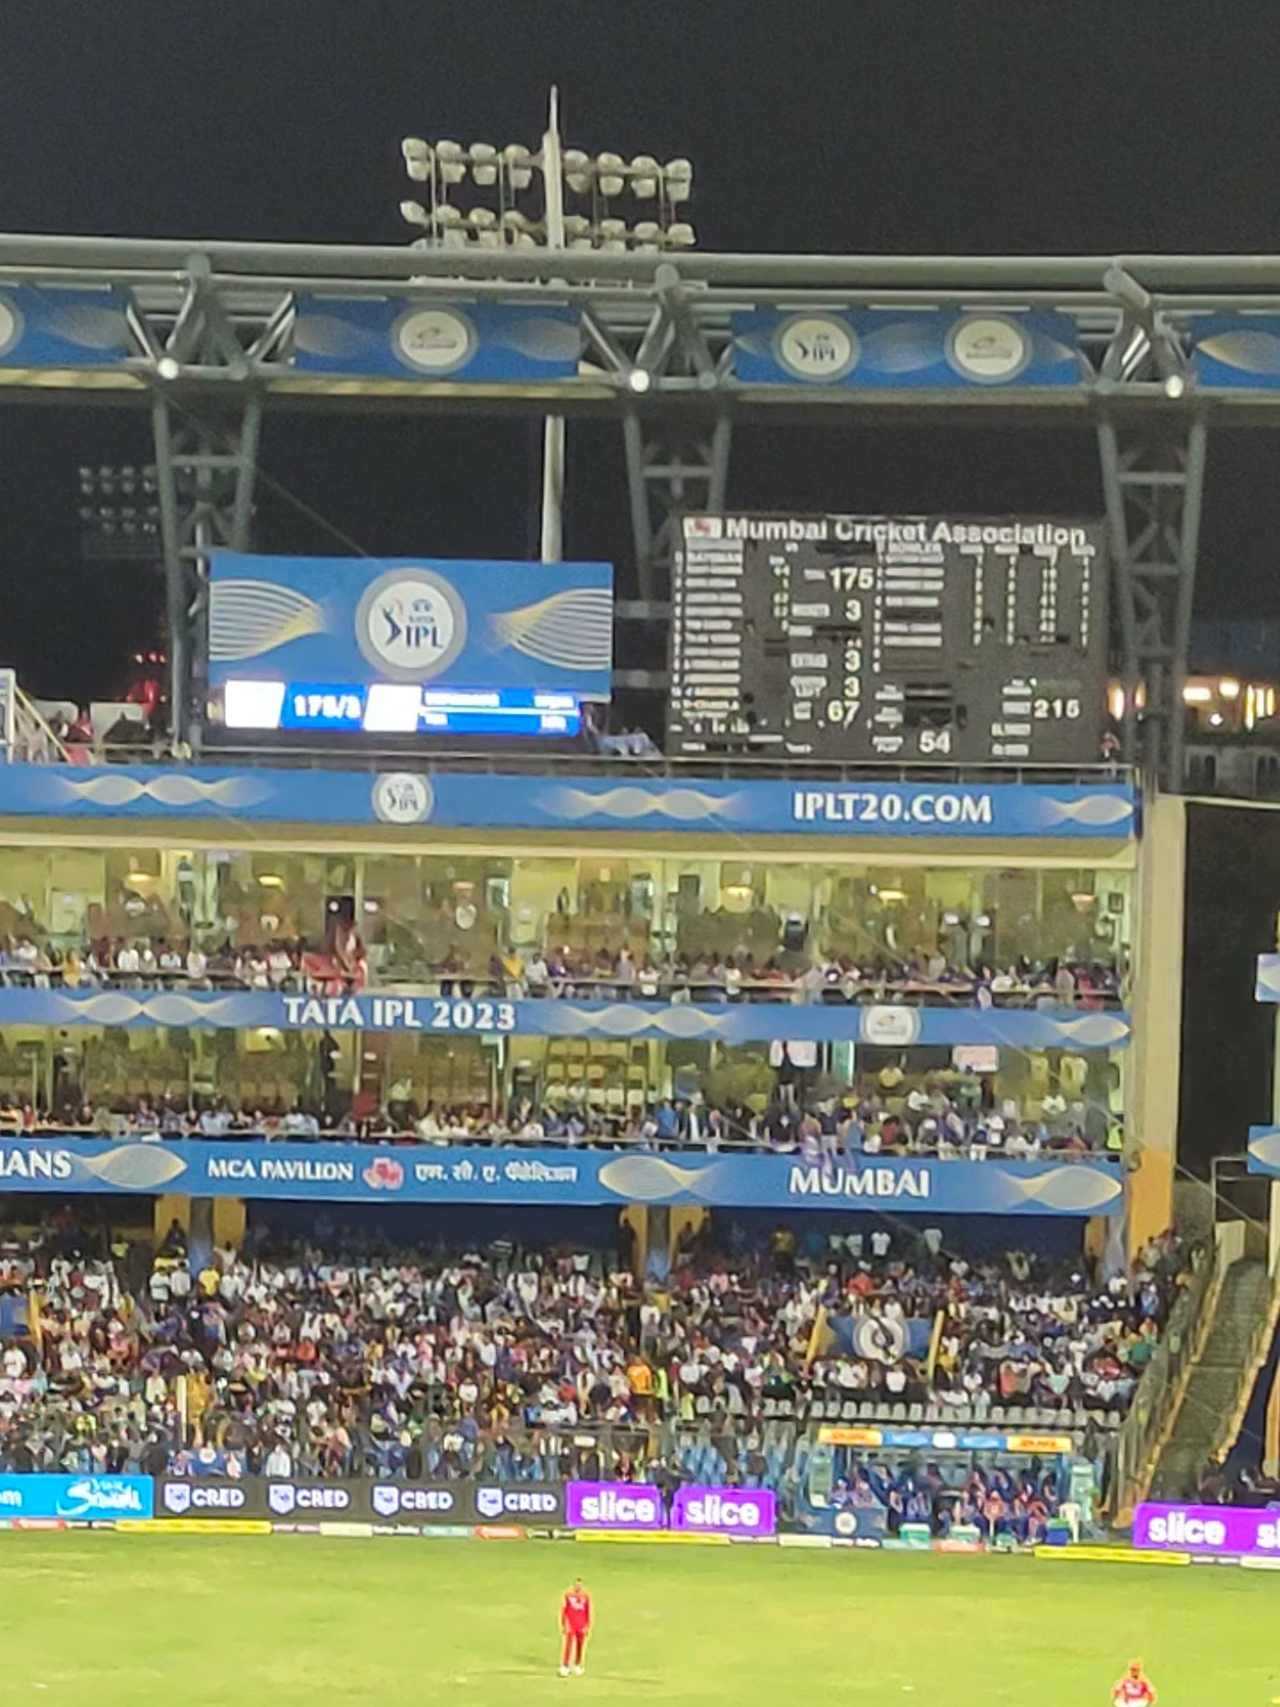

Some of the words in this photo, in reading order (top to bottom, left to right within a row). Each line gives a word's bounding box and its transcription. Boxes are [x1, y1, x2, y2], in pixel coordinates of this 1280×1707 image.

[726, 518, 827, 540] Mumbai
[835, 520, 926, 542] Cricket
[932, 522, 1086, 545] Association
[830, 567, 874, 591] 175
[845, 599, 862, 621] 3
[406, 624, 443, 649] IPL
[845, 650, 861, 671] 3
[844, 676, 860, 697] 3
[827, 700, 860, 725] 67
[1033, 698, 1080, 718] 215
[919, 730, 951, 754] 54
[793, 792, 992, 823] IPLT20.COM
[282, 997, 364, 1025] TATA
[373, 999, 422, 1027] IPL
[431, 1001, 515, 1030] 2023
[208, 1158, 256, 1178] MCA
[261, 1159, 353, 1180] PAVILION
[789, 1167, 930, 1197] MUMBAI
[191, 1489, 245, 1508] CRED
[296, 1490, 349, 1509] CRED
[401, 1491, 453, 1511] CRED
[504, 1493, 557, 1513] CRED
[581, 1494, 655, 1523] slice
[686, 1496, 760, 1527] slice
[1149, 1512, 1225, 1545] slice
